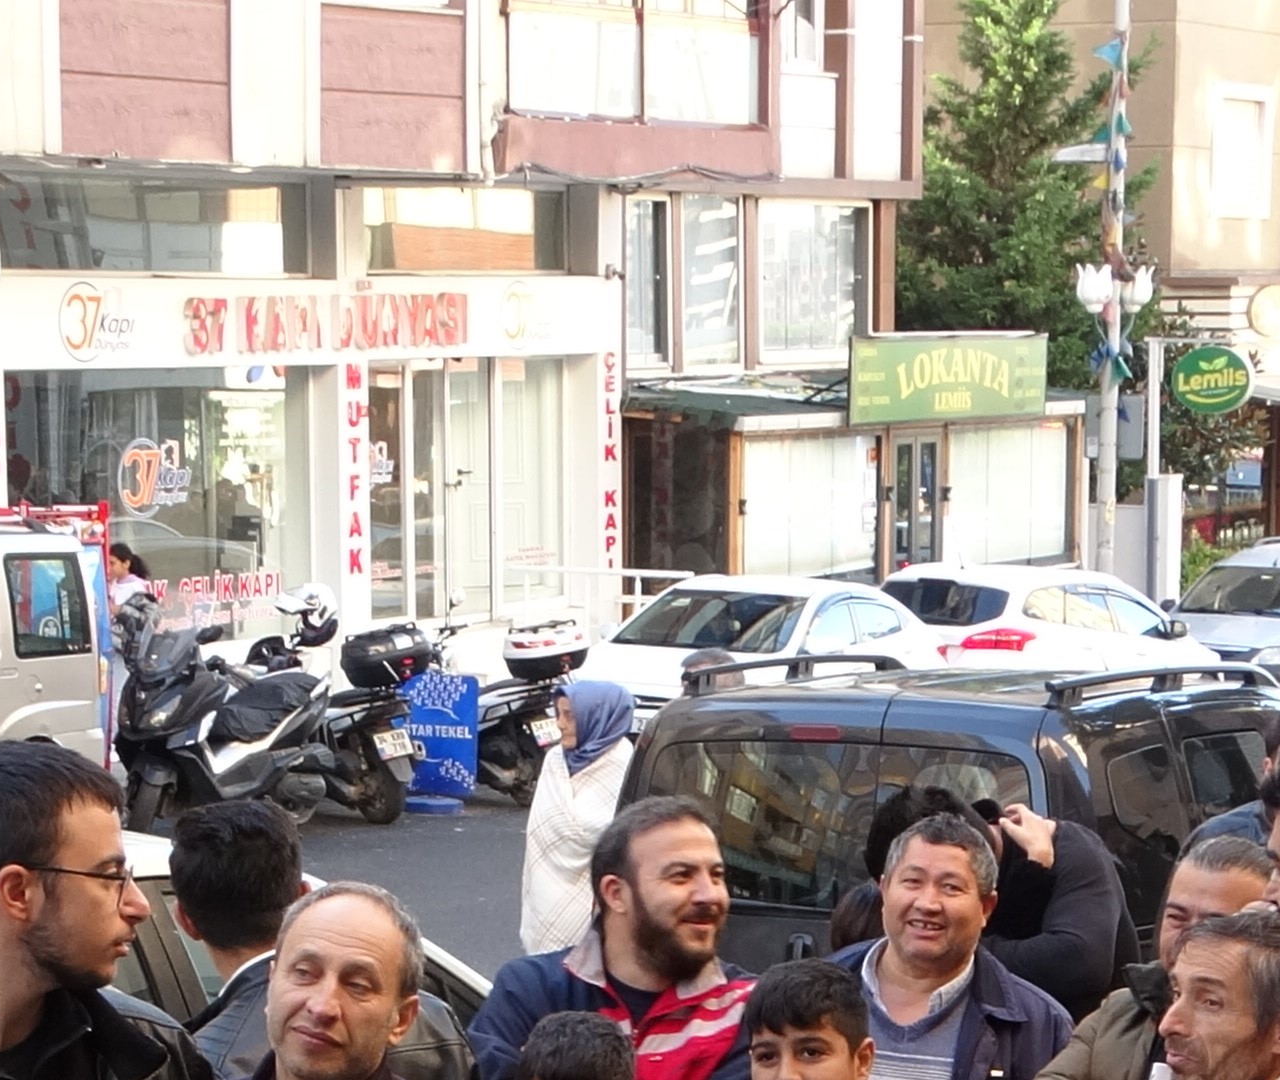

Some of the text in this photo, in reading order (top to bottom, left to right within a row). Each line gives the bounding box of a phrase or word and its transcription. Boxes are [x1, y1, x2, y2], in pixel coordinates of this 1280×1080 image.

[65, 293, 102, 350] 37
[184, 297, 228, 356] 37
[897, 348, 1010, 400] LOKANTA
[603, 351, 618, 462] ÇELİK
[123, 448, 161, 508] 37
[346, 363, 364, 575] MUTFAK
[238, 571, 283, 601] KAPI
[435, 725, 473, 739] TEKEL
